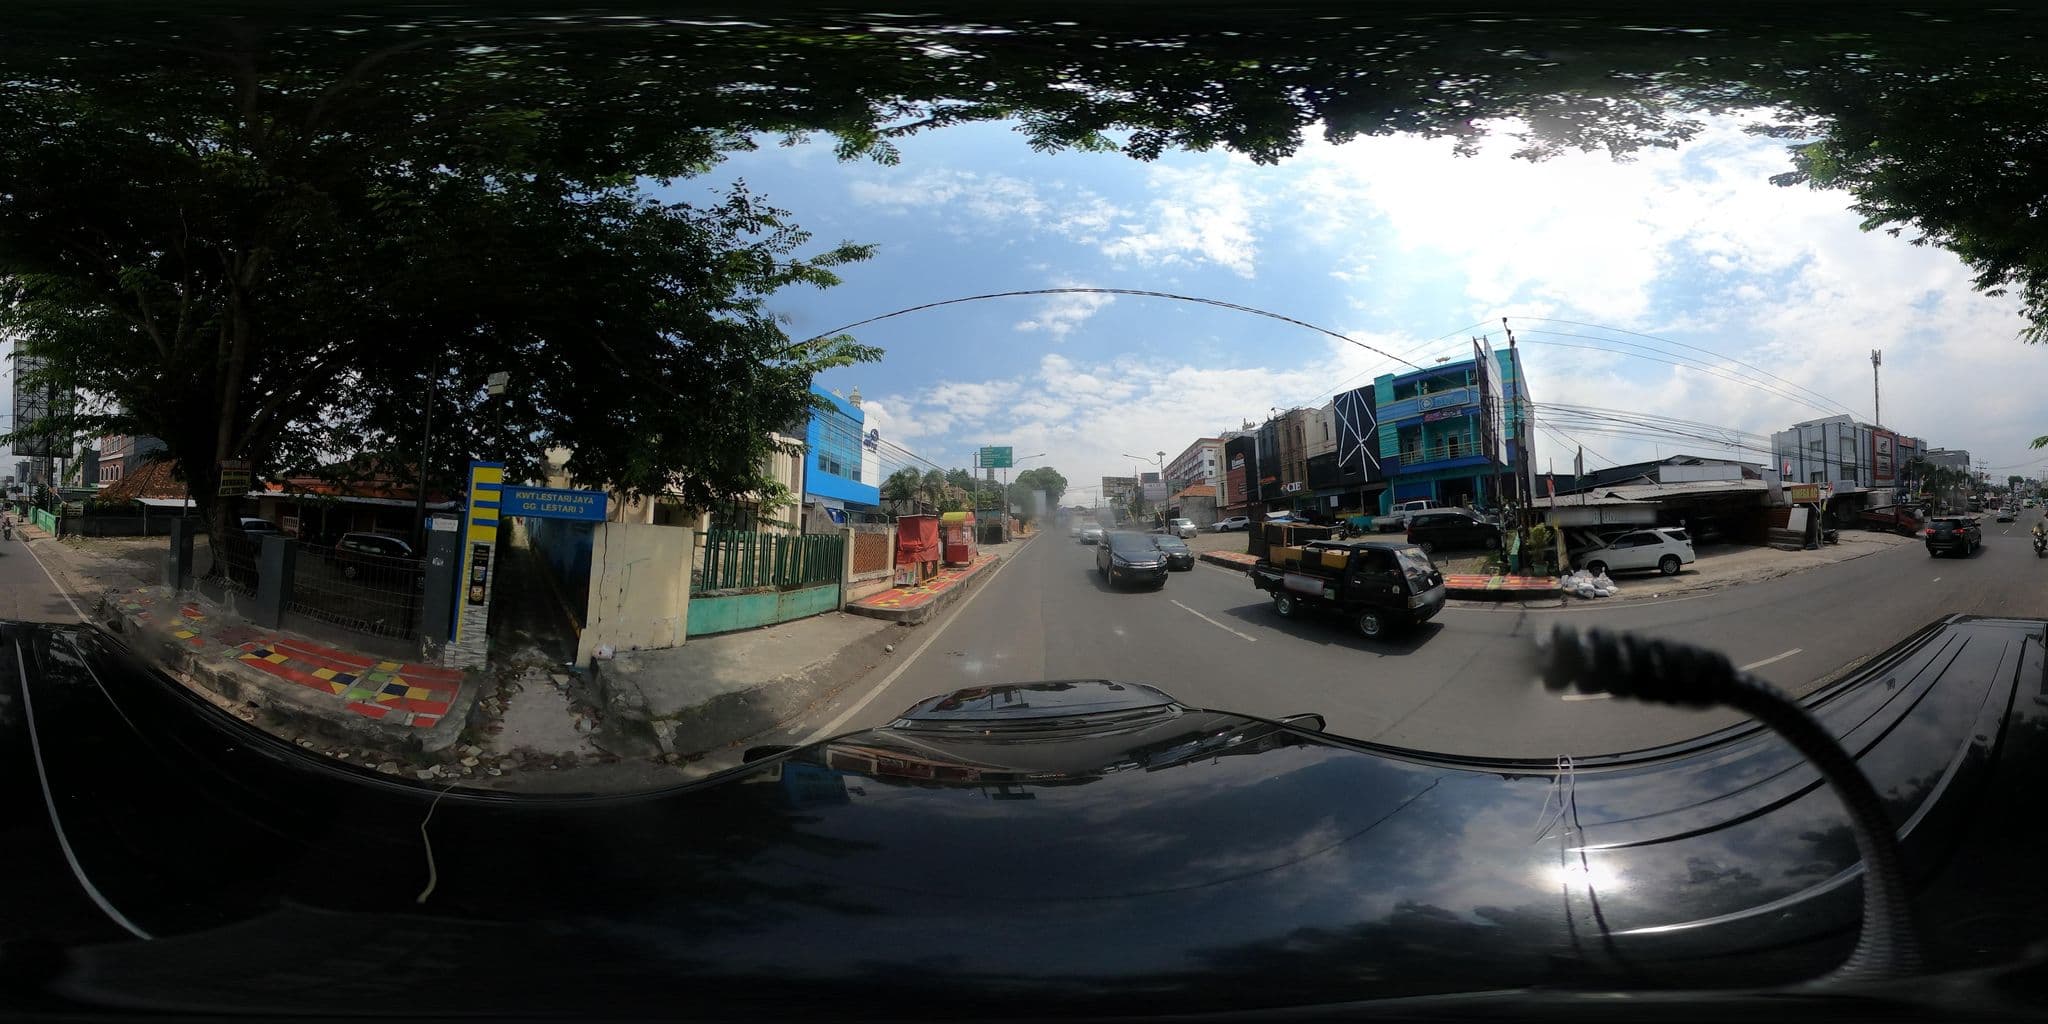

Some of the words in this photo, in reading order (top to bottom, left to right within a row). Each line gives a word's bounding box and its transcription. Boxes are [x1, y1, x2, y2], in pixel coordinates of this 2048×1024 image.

[516, 491, 536, 500] KWT
[536, 493, 571, 503] LESTARI
[572, 496, 594, 505] JAYA
[541, 504, 576, 513] LESTARI
